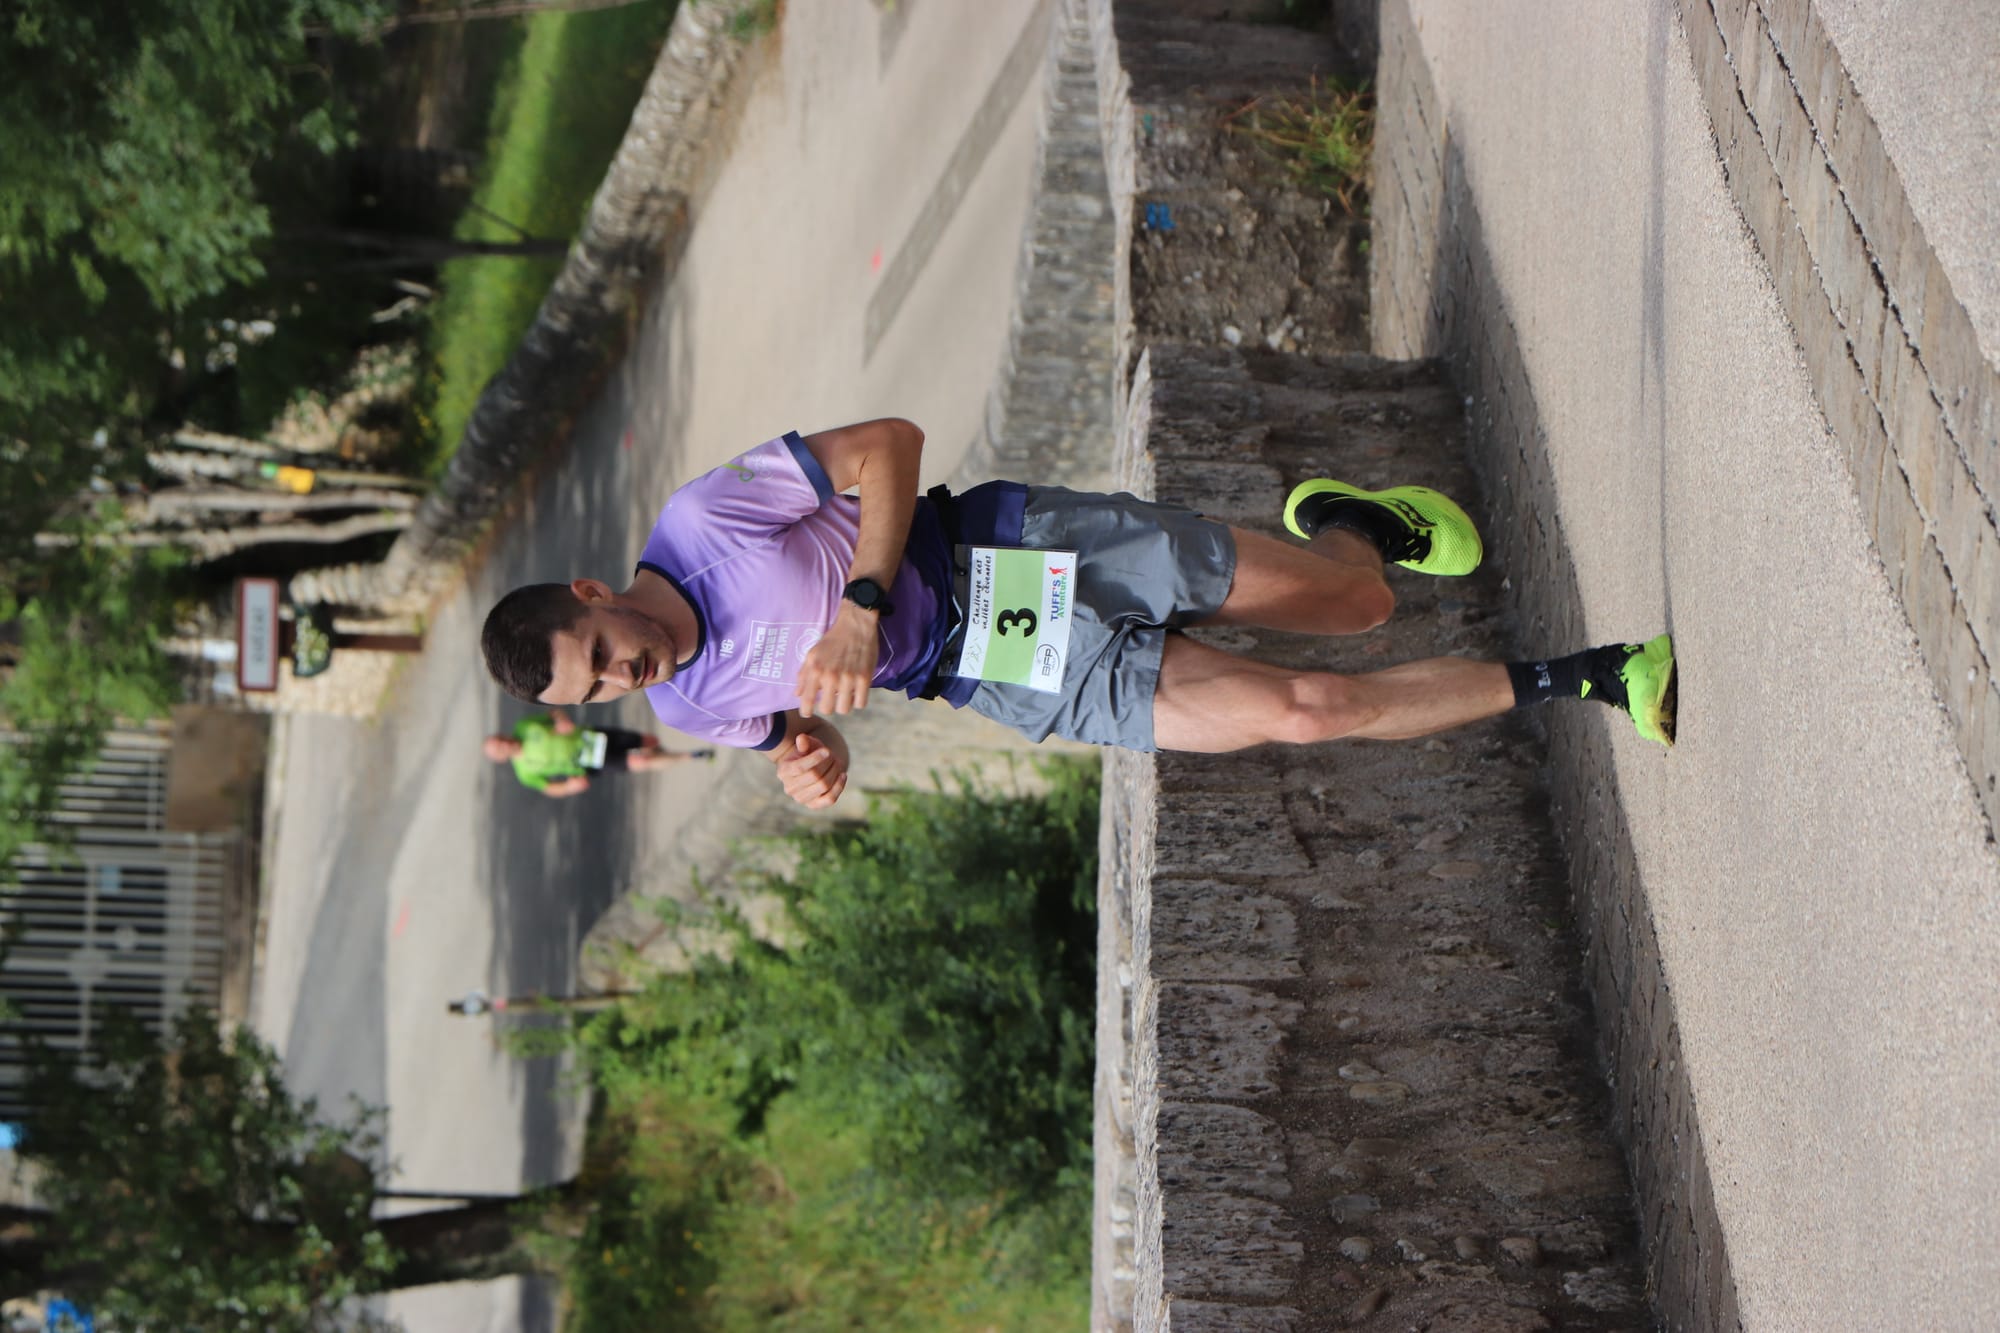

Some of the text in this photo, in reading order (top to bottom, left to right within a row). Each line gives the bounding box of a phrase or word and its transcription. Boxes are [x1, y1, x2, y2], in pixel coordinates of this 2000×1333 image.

[972, 580, 983, 624] Challenge
[1050, 579, 1060, 622] TUFF'S
[1056, 575, 1066, 618] Aventure
[996, 607, 1037, 638] 3
[760, 628, 778, 677] GORGES
[771, 627, 790, 678] DU TARN
